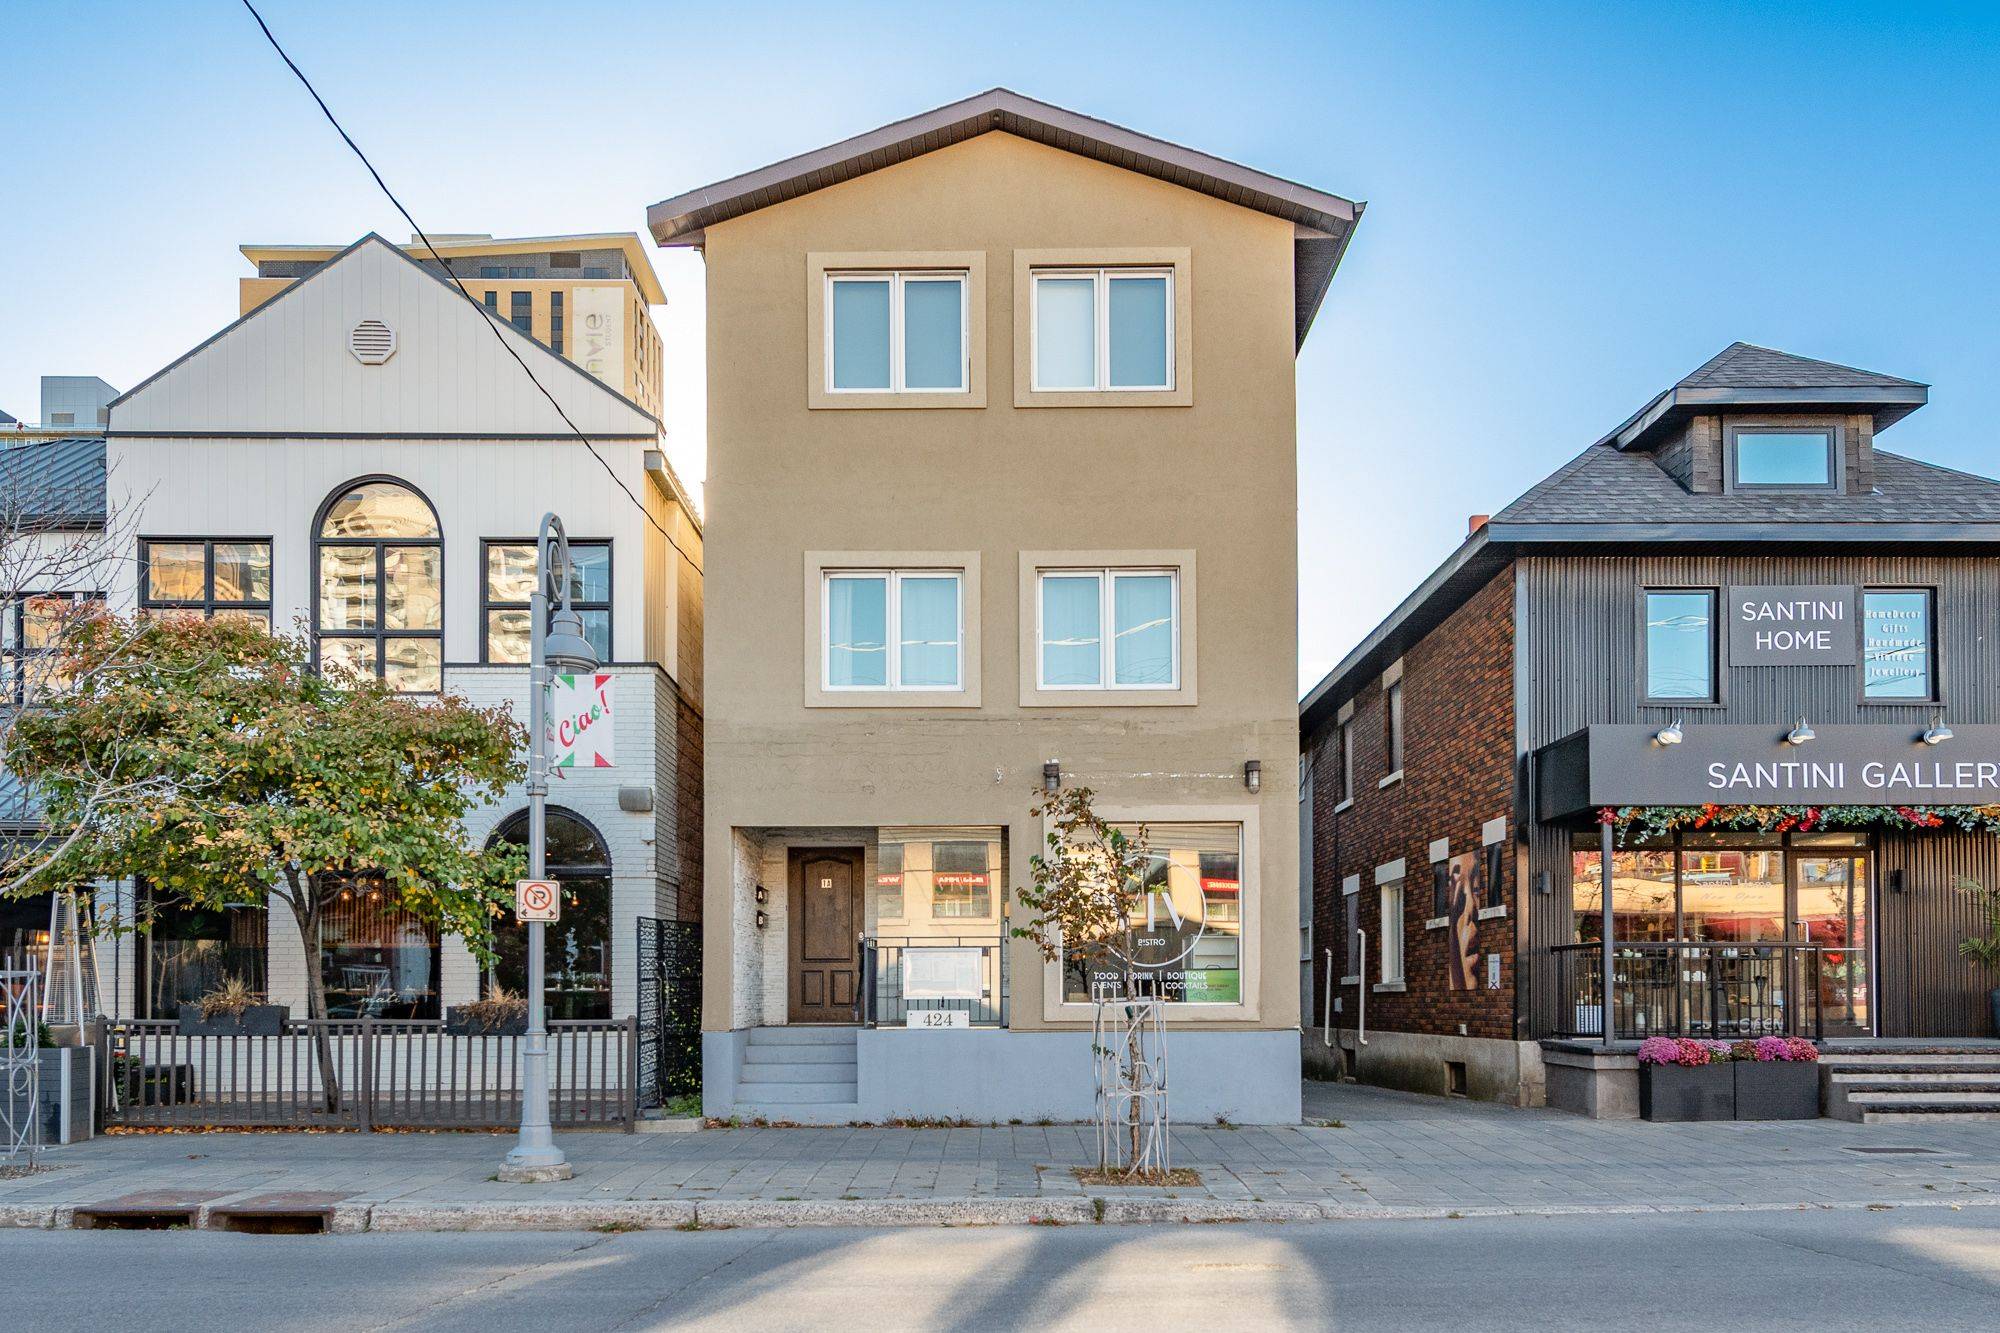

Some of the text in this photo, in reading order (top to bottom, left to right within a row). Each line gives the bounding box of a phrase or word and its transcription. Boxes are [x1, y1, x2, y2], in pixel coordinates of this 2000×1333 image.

[585, 313, 604, 376] nvie
[1742, 601, 1843, 620] SANTINI
[1882, 623, 1908, 634] Gifts
[1756, 630, 1831, 650] HOME
[1868, 638, 1921, 647] Handmade
[1871, 667, 1920, 678] Jewellery
[560, 689, 610, 748] Ciao!
[1708, 762, 2000, 788] SANTINI GALLER
[757, 890, 763, 899] A
[758, 916, 764, 925] B
[1094, 971, 1207, 981] FOOD DRINK BOUTIQUE
[1165, 981, 1209, 990] COCKTAILS
[923, 1013, 953, 1026] 424
